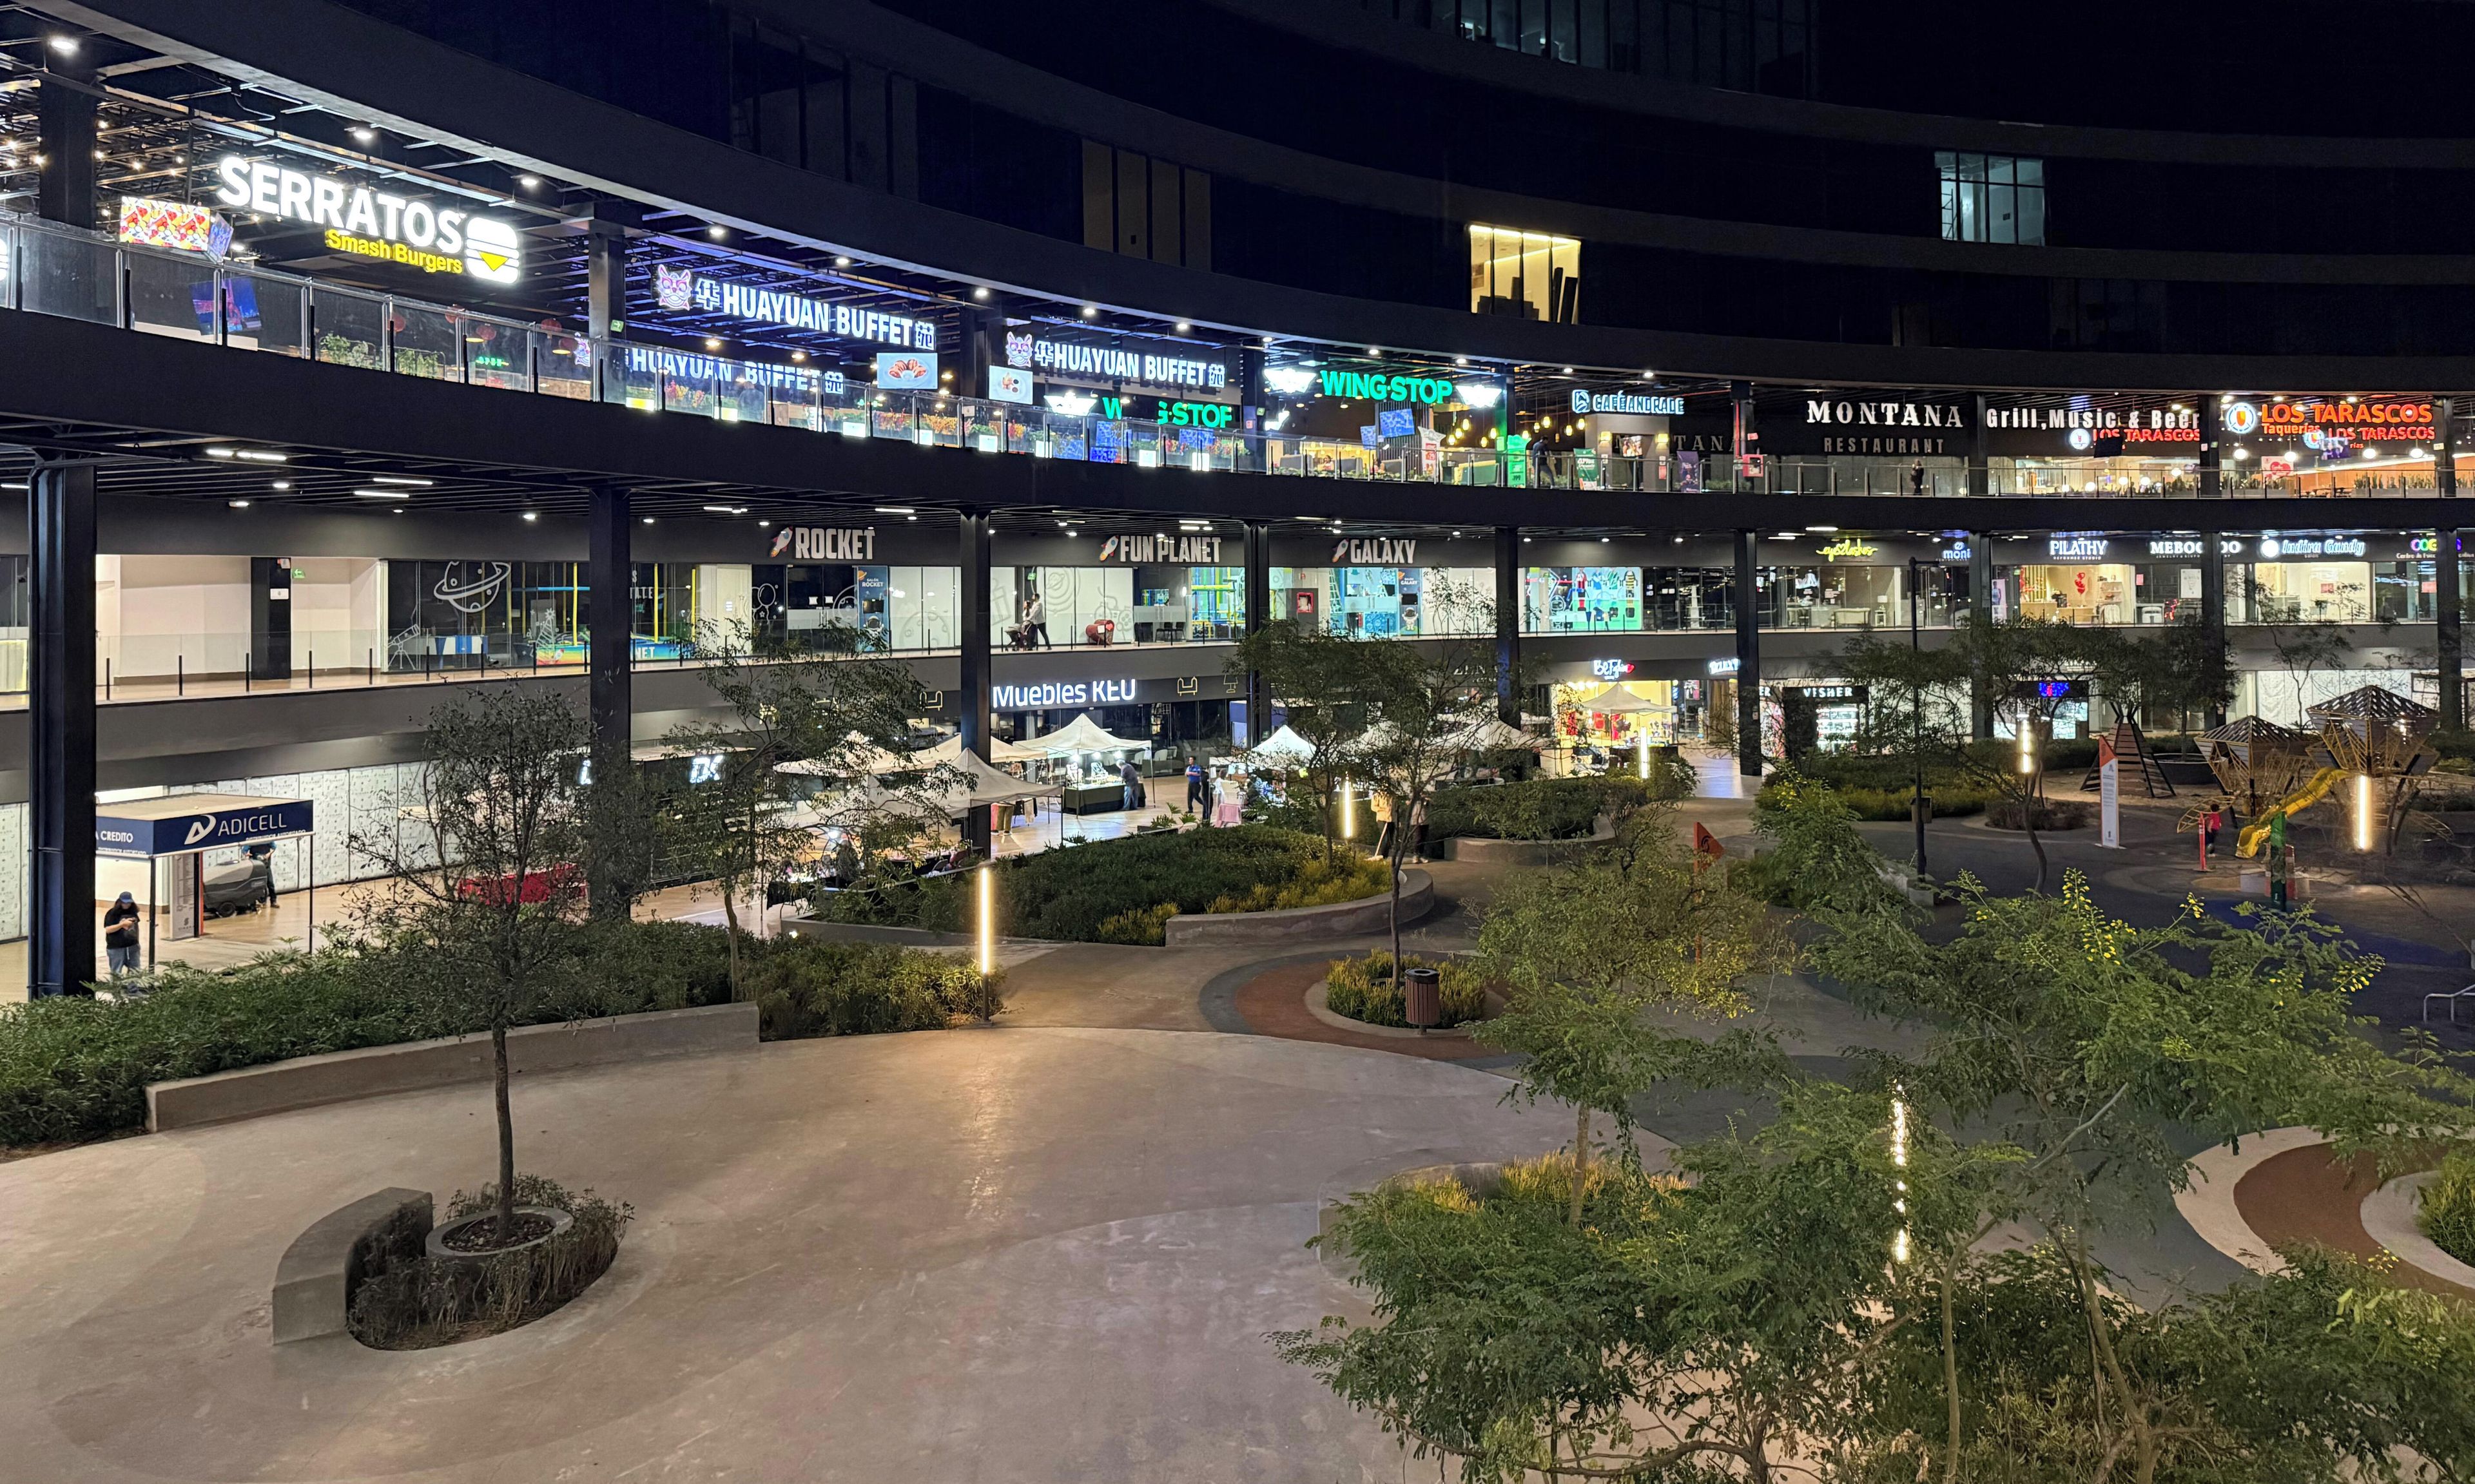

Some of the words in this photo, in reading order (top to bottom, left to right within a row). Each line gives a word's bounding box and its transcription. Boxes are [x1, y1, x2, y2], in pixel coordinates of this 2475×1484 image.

[217, 156, 464, 254] SERRATOS
[325, 229, 391, 259] Smash
[394, 244, 463, 275] Burgers
[722, 282, 831, 332] HUAYUAN
[836, 305, 913, 347] BUFFET
[1054, 342, 1140, 378] HUAYUAN
[1145, 354, 1207, 386] BUFFET
[1806, 400, 1964, 428] MONTANA
[2128, 410, 2139, 429] &
[2261, 403, 2305, 424] LOS
[2309, 403, 2432, 424] TARASCOS
[1823, 437, 1945, 454] RESTAURANT
[2358, 426, 2435, 441] TARASCOS
[795, 527, 876, 560] ROCKET
[1120, 535, 1154, 562] FUN
[1157, 536, 1221, 563] PLANET
[1350, 539, 1416, 564] GALAXY
[1943, 548, 1971, 559] moni
[2050, 540, 2108, 555] PILATHY
[993, 682, 1087, 709] Muebles
[1803, 687, 1853, 697] VISHER
[101, 831, 133, 843] CREDITO
[218, 813, 287, 837] ADICELL
